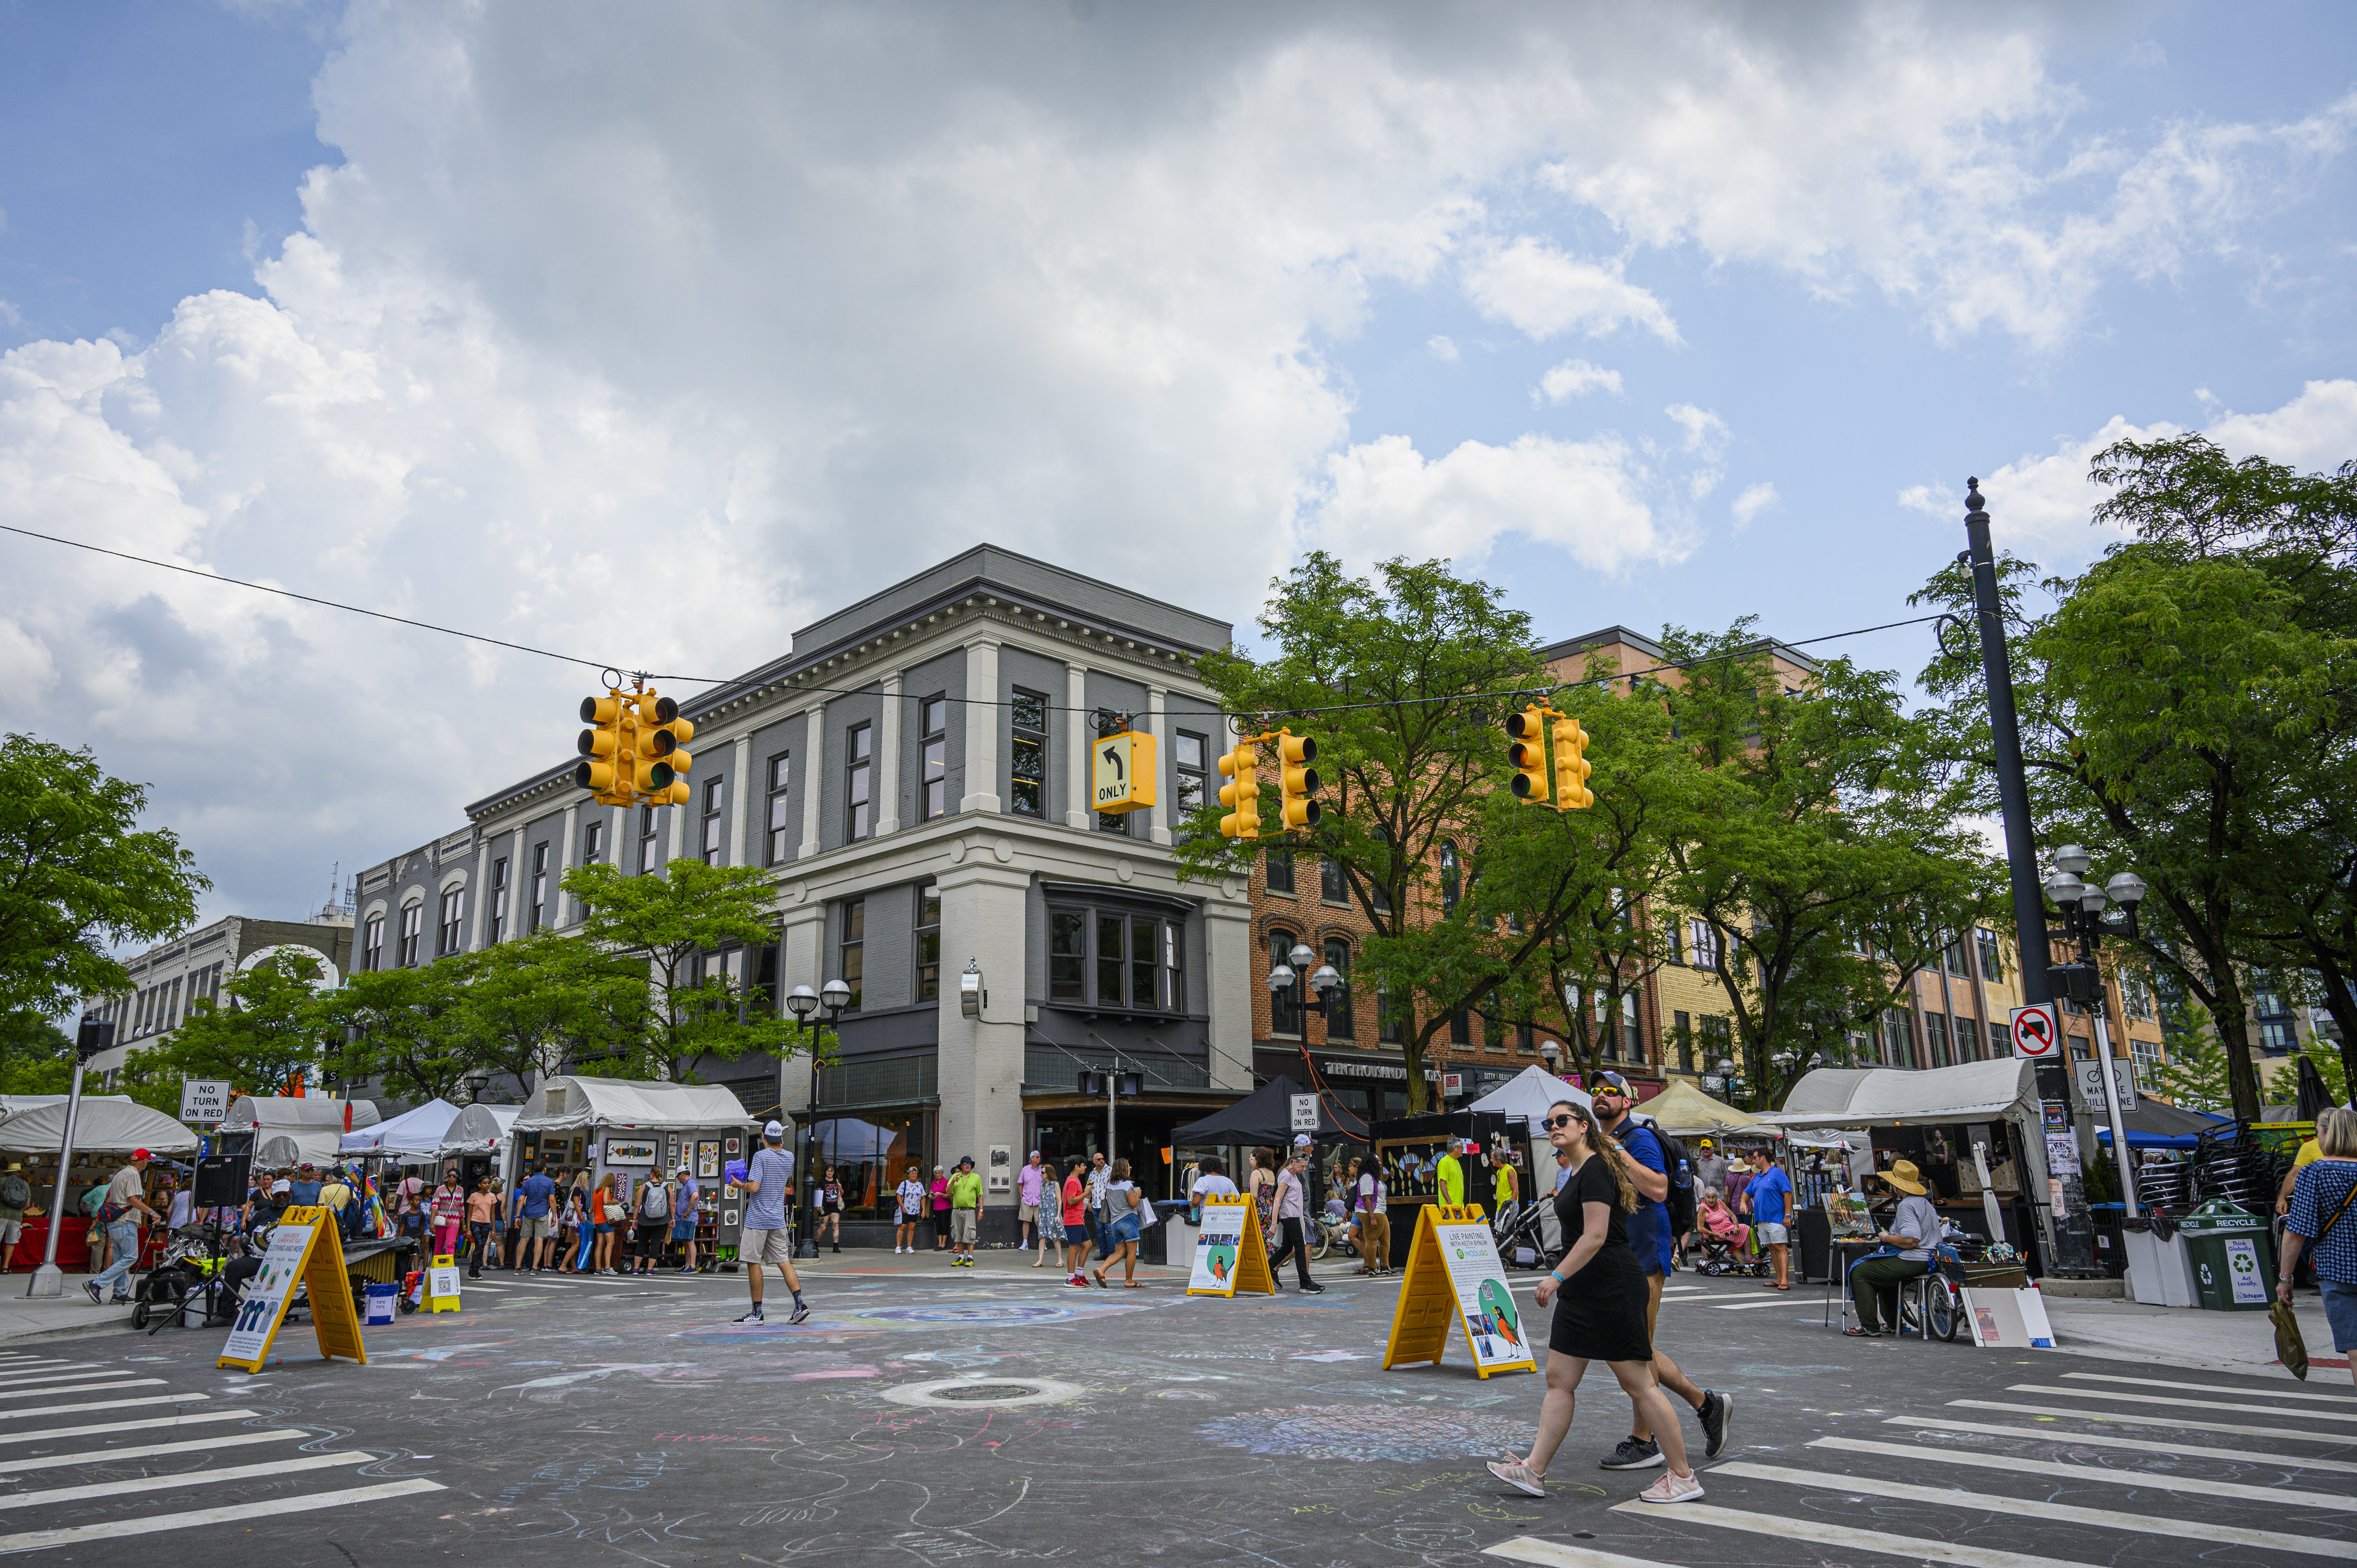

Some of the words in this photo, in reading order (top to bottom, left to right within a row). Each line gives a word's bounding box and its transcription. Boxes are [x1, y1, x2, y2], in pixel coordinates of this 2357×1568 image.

[1099, 783, 1126, 800] ONLY
[1325, 1062, 1348, 1075] TEN
[1347, 1064, 1402, 1079] THOUSAND
[199, 1086, 215, 1094] NO
[2087, 1087, 2104, 1095] MAY
[193, 1097, 219, 1105] TURN
[185, 1109, 199, 1117] ON
[203, 1109, 223, 1117] RED
